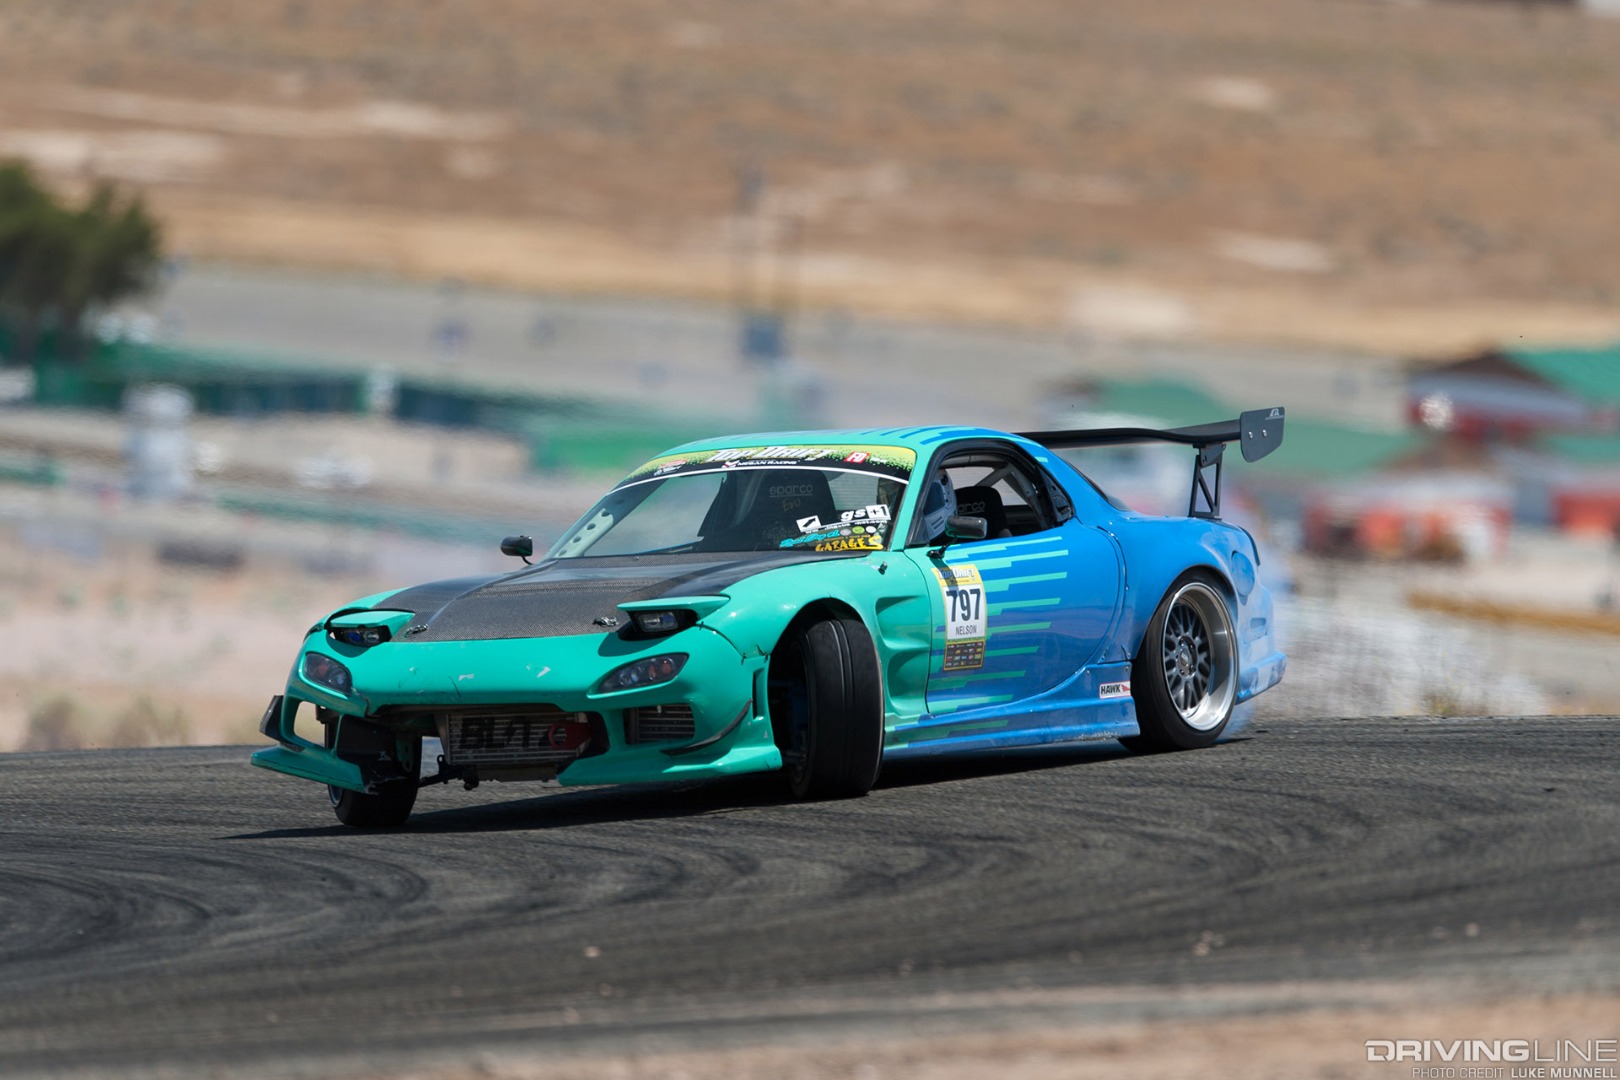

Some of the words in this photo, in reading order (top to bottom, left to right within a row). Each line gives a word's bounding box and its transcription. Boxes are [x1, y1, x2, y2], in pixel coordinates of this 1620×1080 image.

[946, 588, 982, 622] 797
[955, 624, 977, 635] NELSON
[1100, 683, 1121, 695] HAWK
